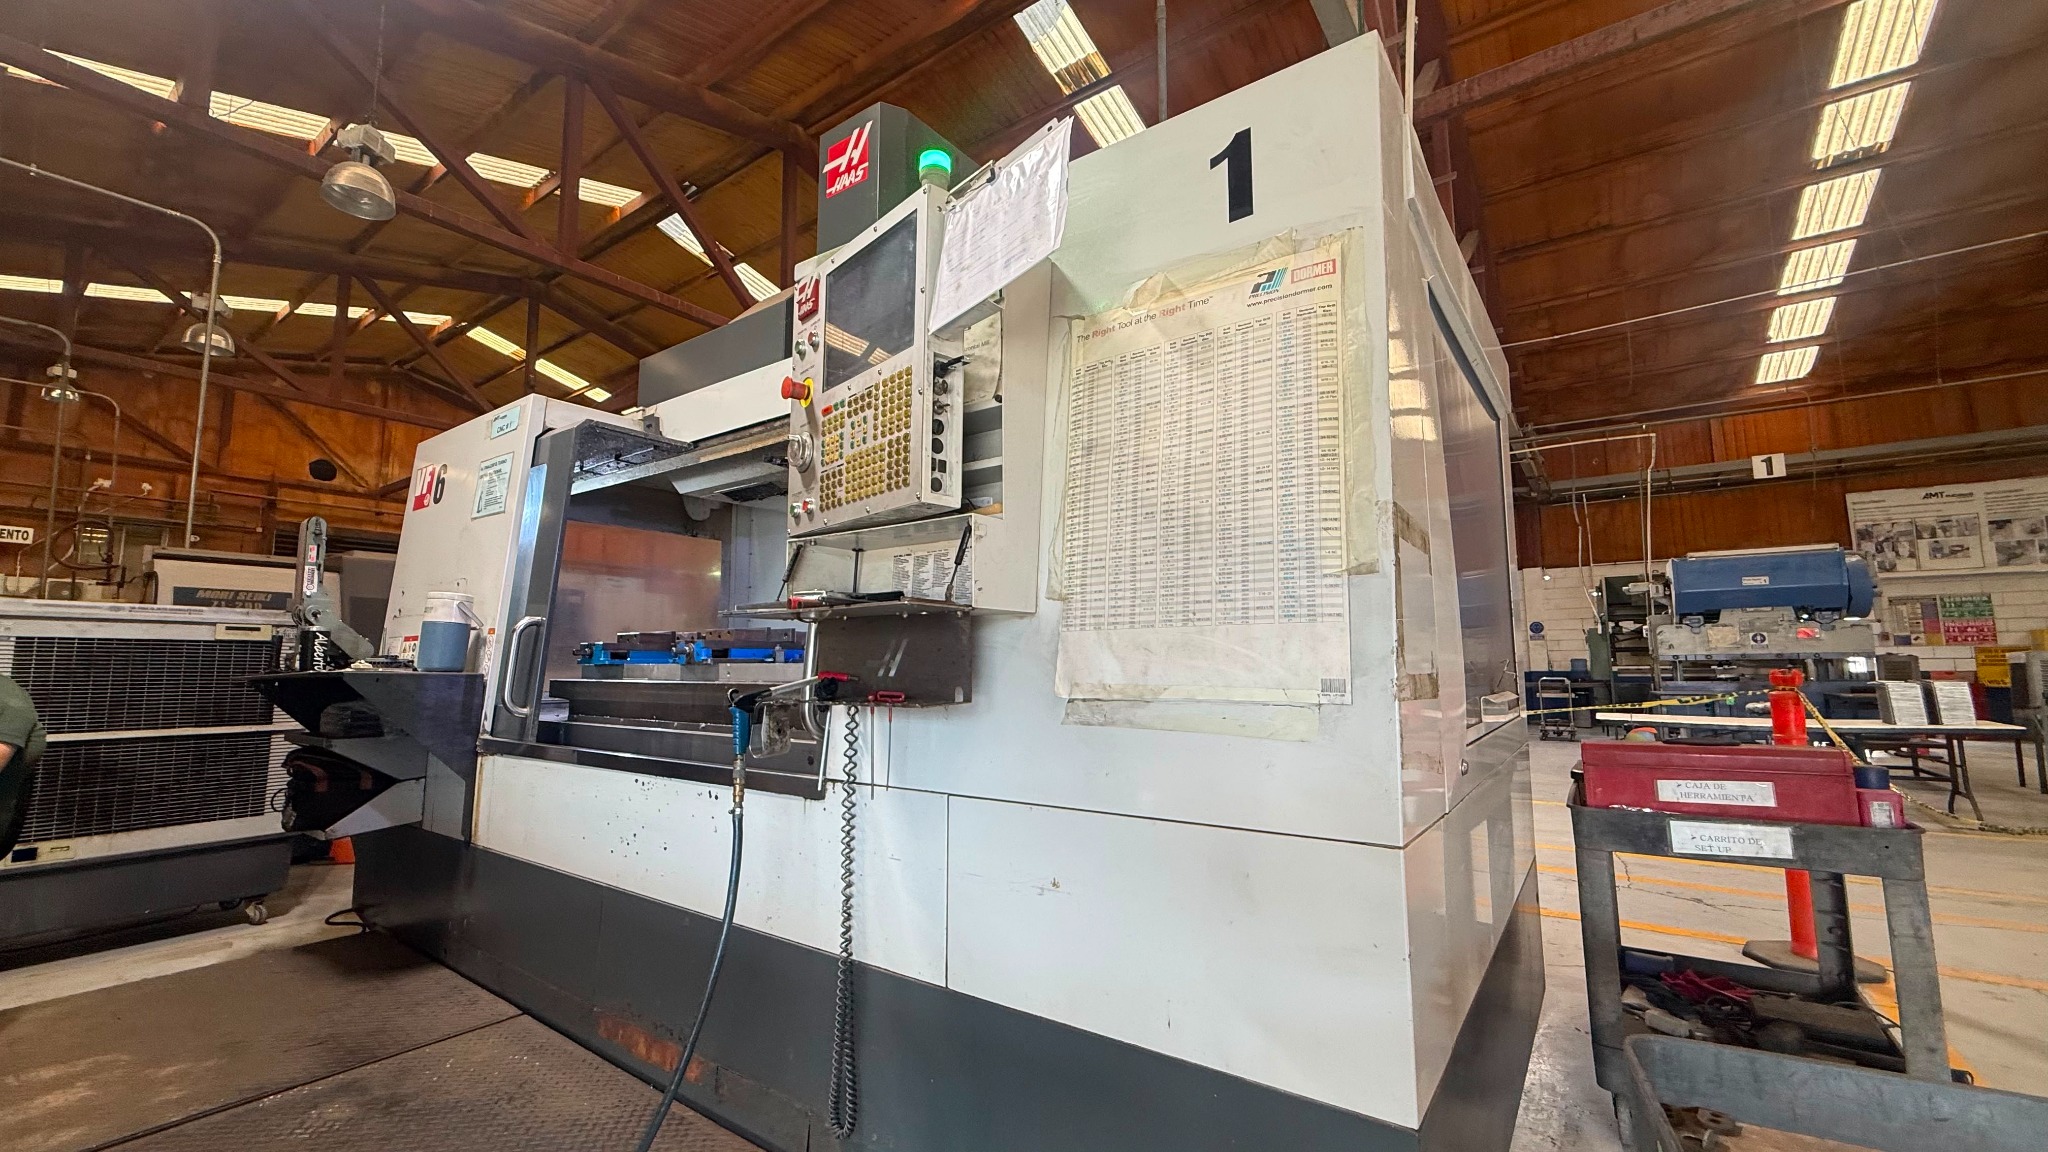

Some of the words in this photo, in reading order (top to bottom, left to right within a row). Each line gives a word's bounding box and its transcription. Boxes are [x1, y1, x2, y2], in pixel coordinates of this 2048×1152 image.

[826, 162, 868, 194] HAAS
[1209, 127, 1253, 223] 1
[1294, 261, 1333, 281] DORMER
[1247, 284, 1333, 307] www.precisiondormer.com
[1076, 334, 1091, 343] The
[1092, 325, 1116, 339] Right
[1117, 319, 1133, 331] Tool
[1134, 316, 1143, 326] at
[1144, 313, 1157, 323] the
[1159, 304, 1186, 319] Right
[1761, 456, 1773, 476] 1
[415, 464, 436, 497] VF
[433, 464, 448, 505] 6
[1922, 491, 1945, 500] AMT
[0, 528, 30, 541] ENTO
[195, 589, 236, 600] MORI
[236, 591, 273, 602] SEIKI
[313, 631, 328, 671] Alberto
[1685, 782, 1710, 790] CAJA
[1680, 791, 1754, 802] HERRAMIENTA
[1694, 844, 1714, 852] SET
[1717, 846, 1732, 854] UP
[1700, 834, 1745, 844] CARRITO
[1748, 838, 1762, 846] DE
